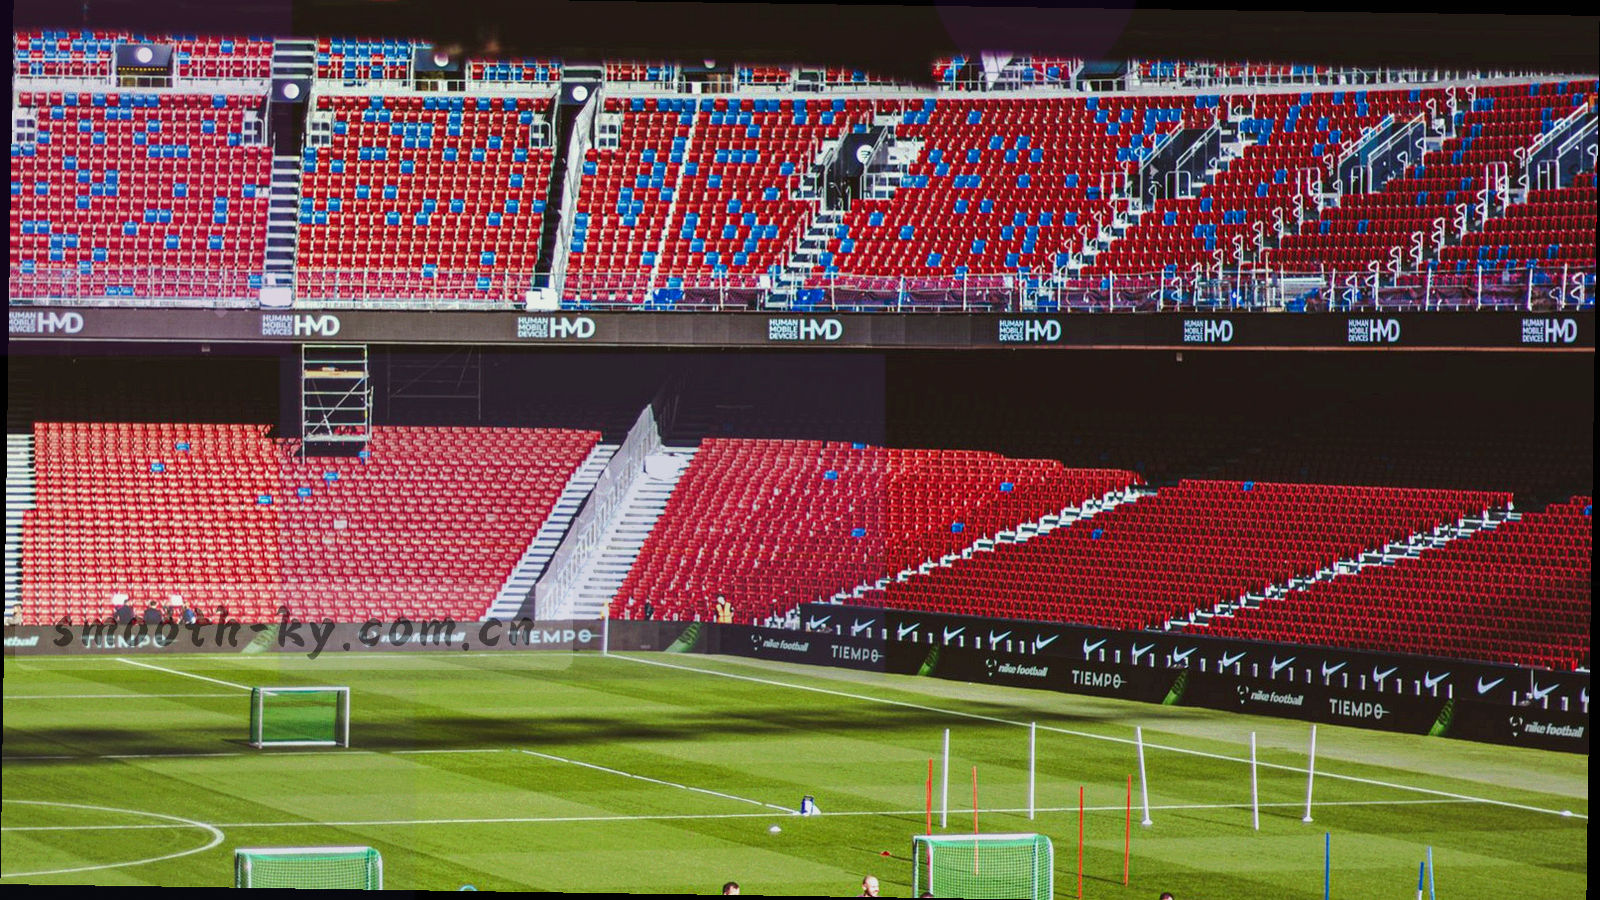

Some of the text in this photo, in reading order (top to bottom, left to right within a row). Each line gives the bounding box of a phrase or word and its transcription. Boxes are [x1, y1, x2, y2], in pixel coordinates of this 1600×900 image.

[38, 312, 84, 333] HMD
[294, 315, 340, 336] HMD
[550, 317, 596, 338] HMD
[800, 319, 843, 340] HMD
[1025, 320, 1061, 341] HMD
[1204, 320, 1233, 342] HMD
[1370, 320, 1400, 341] HMD
[1545, 319, 1577, 342] HMD
[507, 629, 592, 644] TIEMPO
[763, 639, 809, 652] nike football
[831, 645, 880, 663] TIEMPO
[998, 663, 1048, 677] nike football
[1072, 670, 1122, 689] TIEMPO
[1251, 690, 1304, 706] nike football
[1329, 698, 1384, 720] TIEMPO
[1525, 721, 1584, 738] nike football
